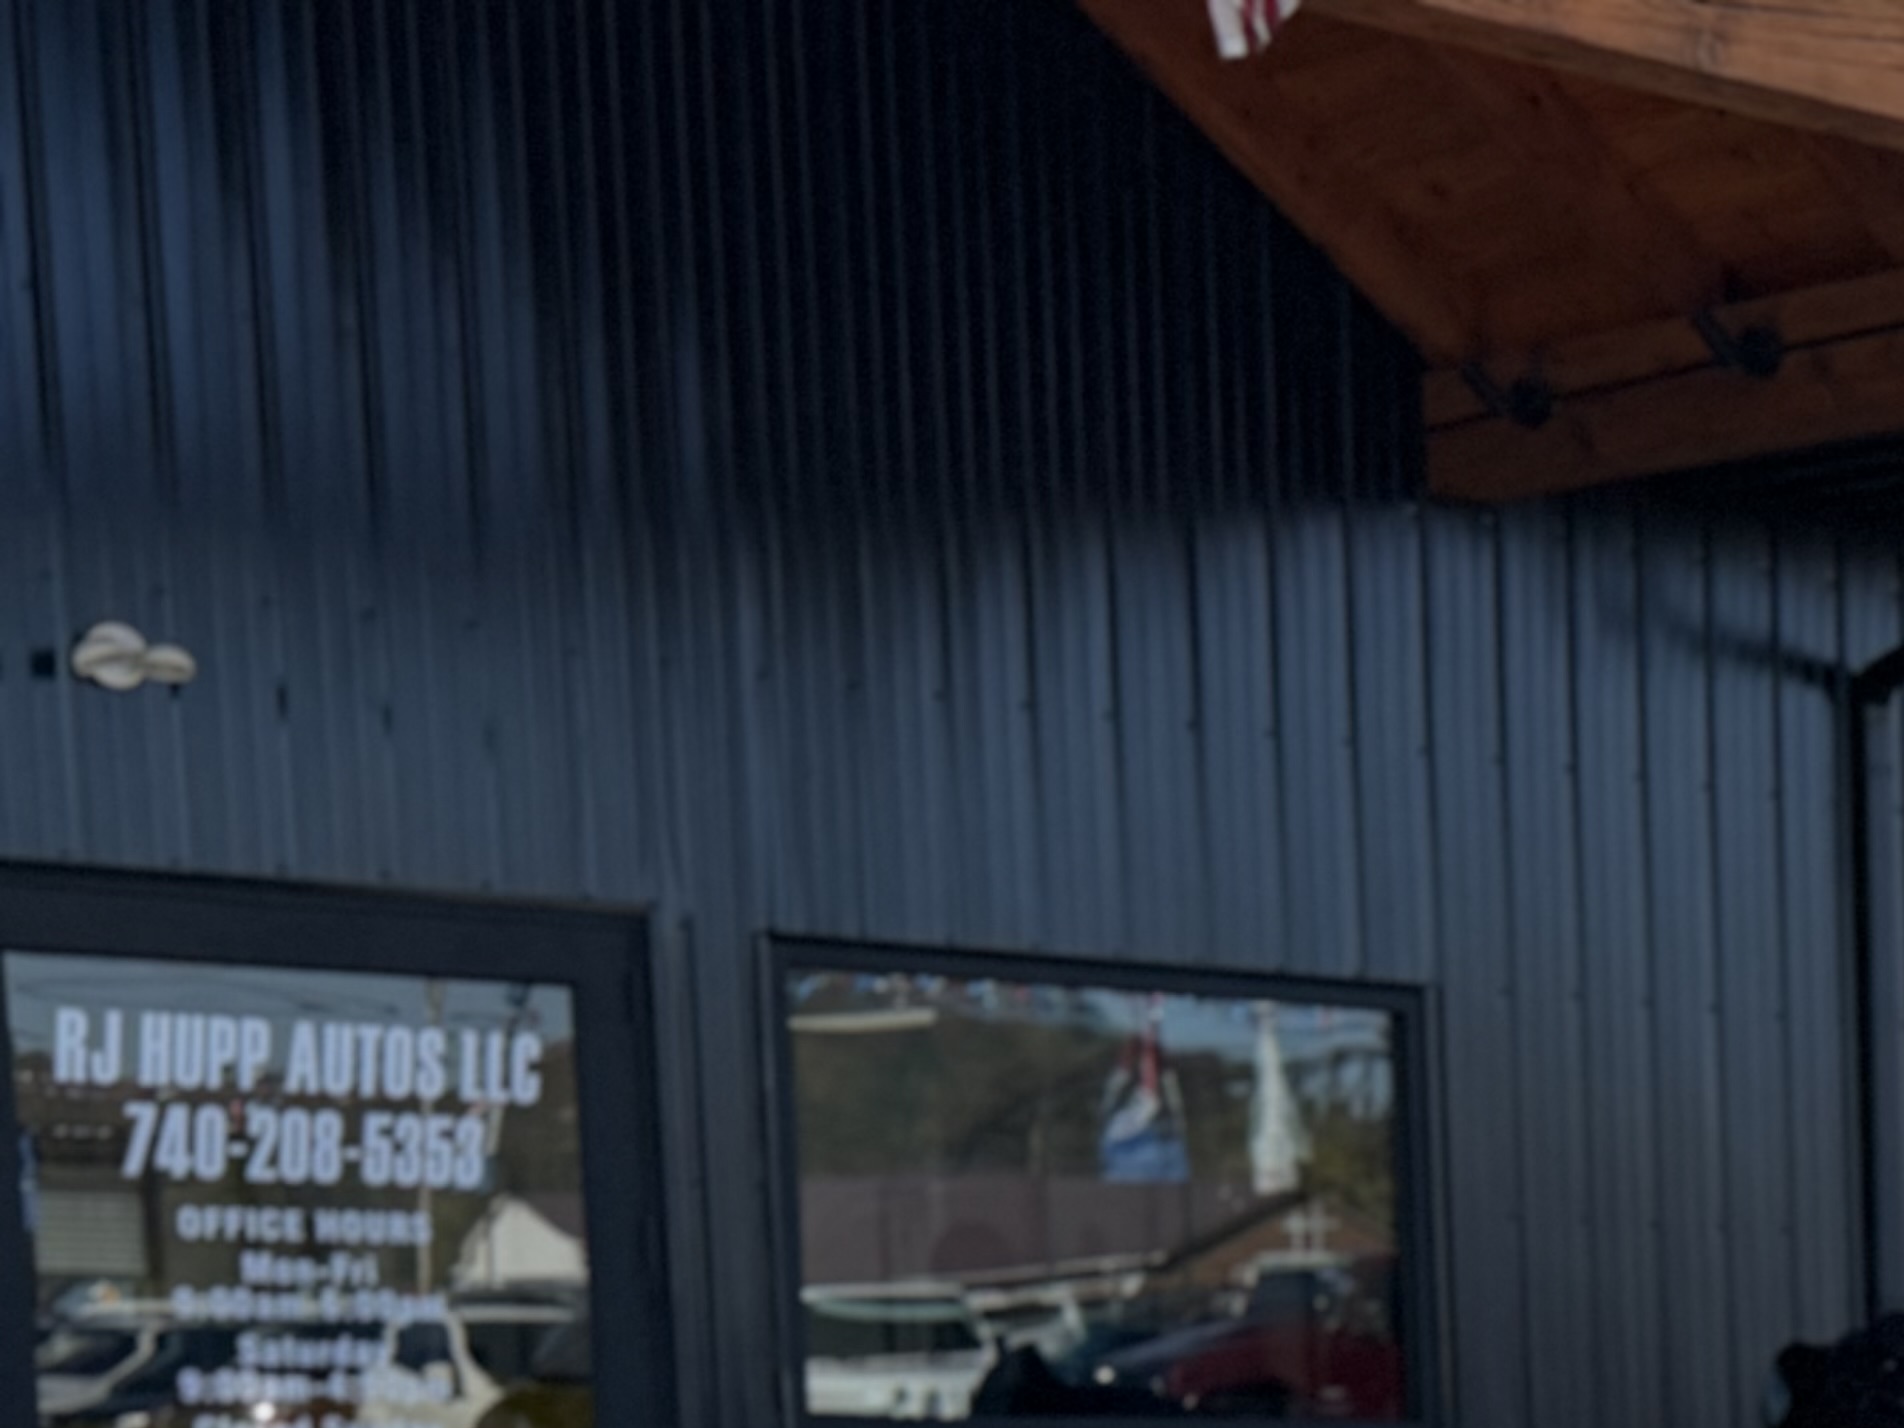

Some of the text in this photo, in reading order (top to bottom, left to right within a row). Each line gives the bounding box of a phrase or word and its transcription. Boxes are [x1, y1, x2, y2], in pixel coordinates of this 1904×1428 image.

[53, 1006, 544, 1107] RJ HUPP AUTOS LLC
[121, 1101, 486, 1190] 740-208-5353
[176, 1204, 432, 1246] OFFICE HOURS
